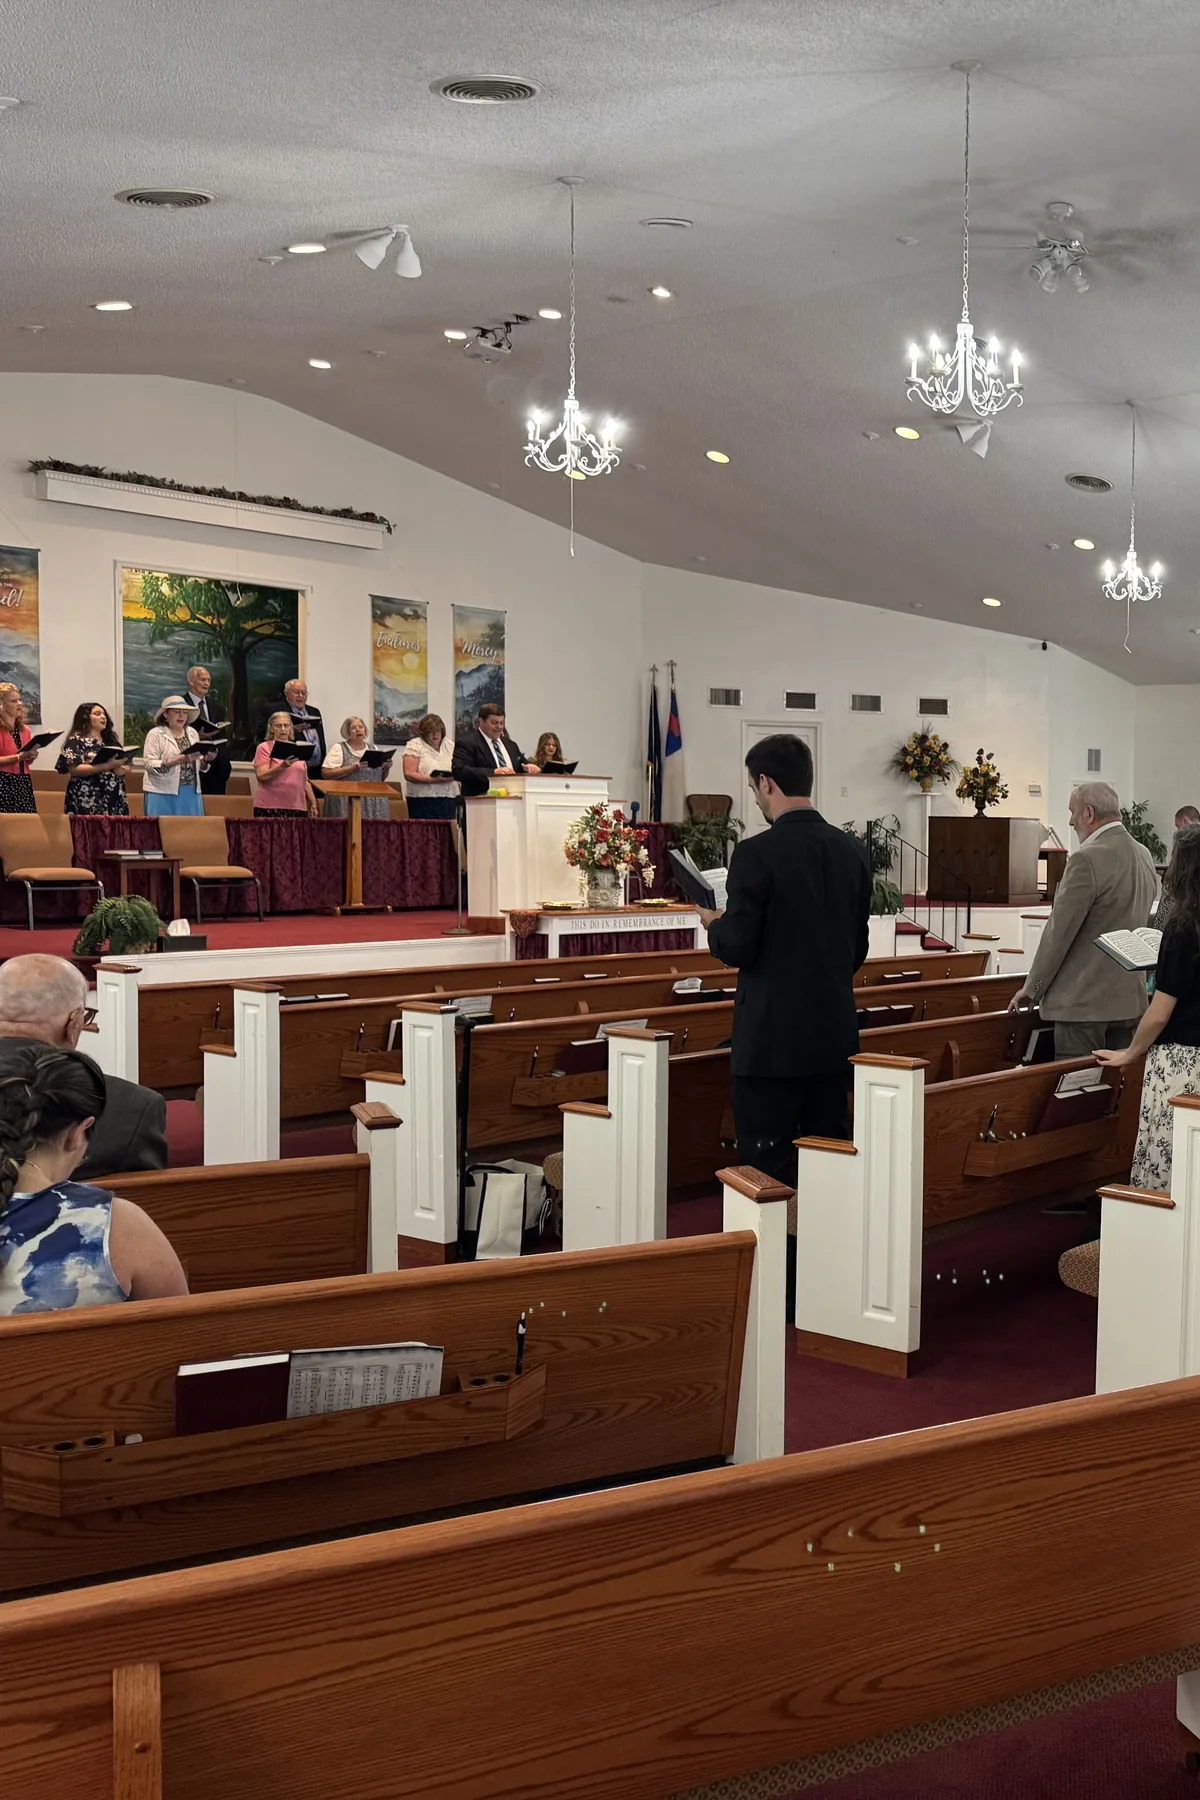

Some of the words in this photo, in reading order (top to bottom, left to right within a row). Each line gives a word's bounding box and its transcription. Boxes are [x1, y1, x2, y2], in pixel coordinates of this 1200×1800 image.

[461, 639, 498, 664] Mercy
[571, 919, 586, 930] THIS
[589, 919, 599, 929] DO
[601, 918, 609, 929] IN
[613, 916, 664, 929] REMEMBRANCE
[666, 916, 675, 927] OF
[676, 915, 687, 926] ME
